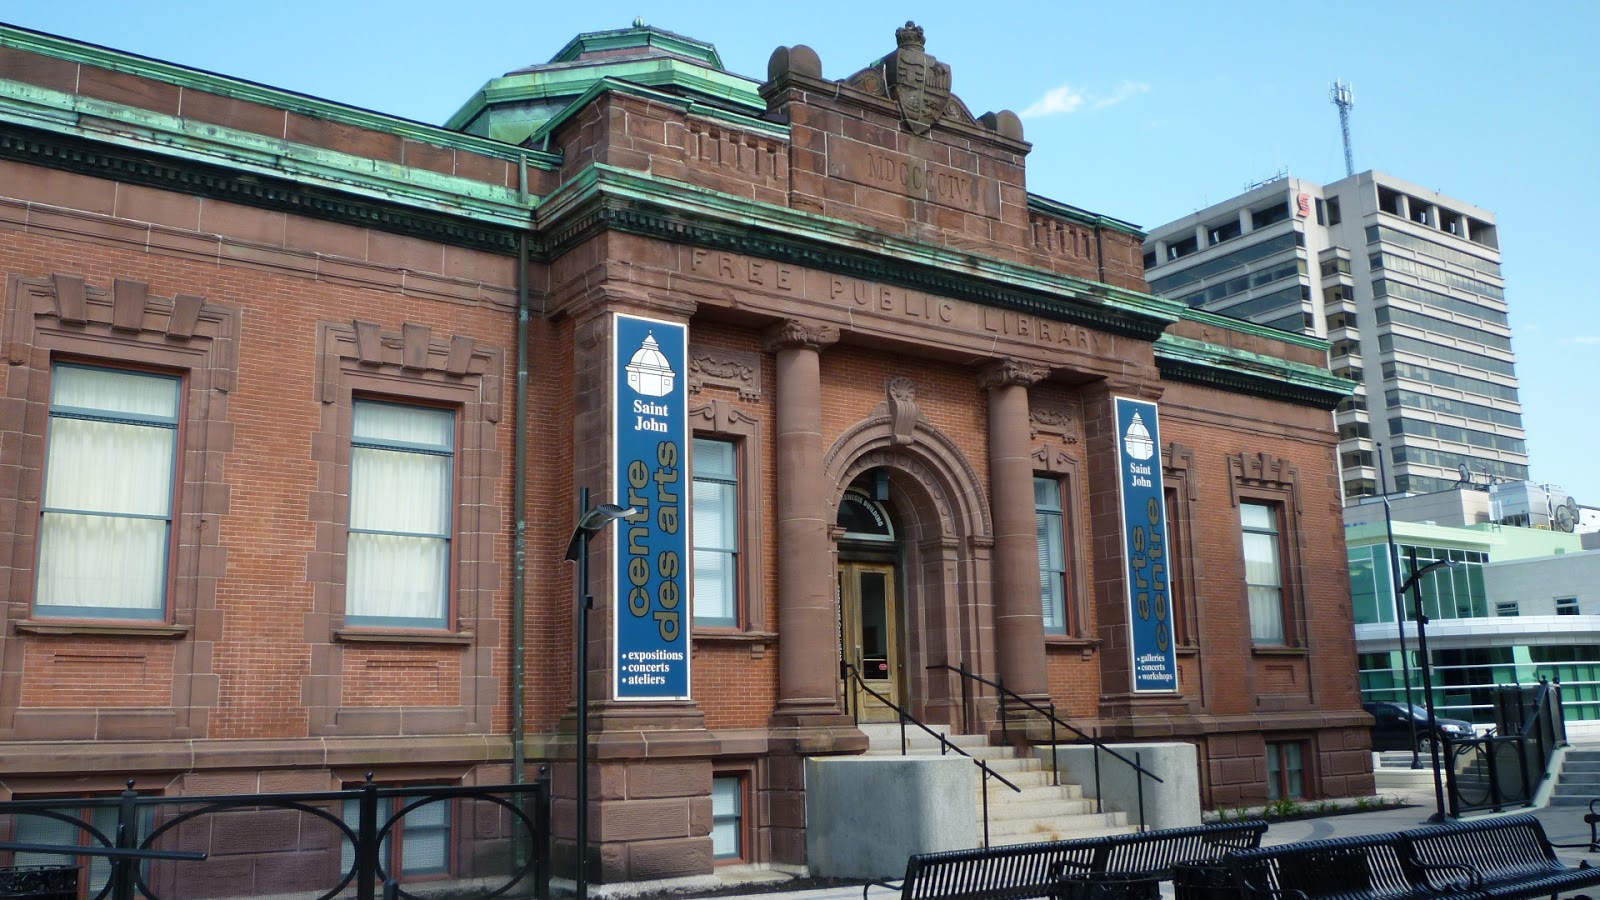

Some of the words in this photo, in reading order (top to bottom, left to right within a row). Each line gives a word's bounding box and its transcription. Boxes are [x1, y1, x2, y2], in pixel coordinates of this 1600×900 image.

[690, 251, 793, 291] FREE
[829, 277, 953, 323] PUBLIC
[983, 308, 1101, 349] LIBRARY
[633, 399, 669, 417] Saint
[634, 416, 668, 433] John
[1130, 461, 1151, 475] Saint
[653, 440, 679, 536] arts
[1131, 475, 1152, 488] John
[862, 499, 884, 527] BUILDING
[624, 459, 650, 618] centre
[1132, 524, 1150, 622] arts
[1147, 496, 1168, 652] centre
[653, 551, 680, 642] des
[627, 649, 684, 663] expositions
[1140, 653, 1165, 664] galleries
[627, 662, 670, 673] concerts
[627, 673, 666, 685] ateliers
[1141, 672, 1173, 682] workshops
